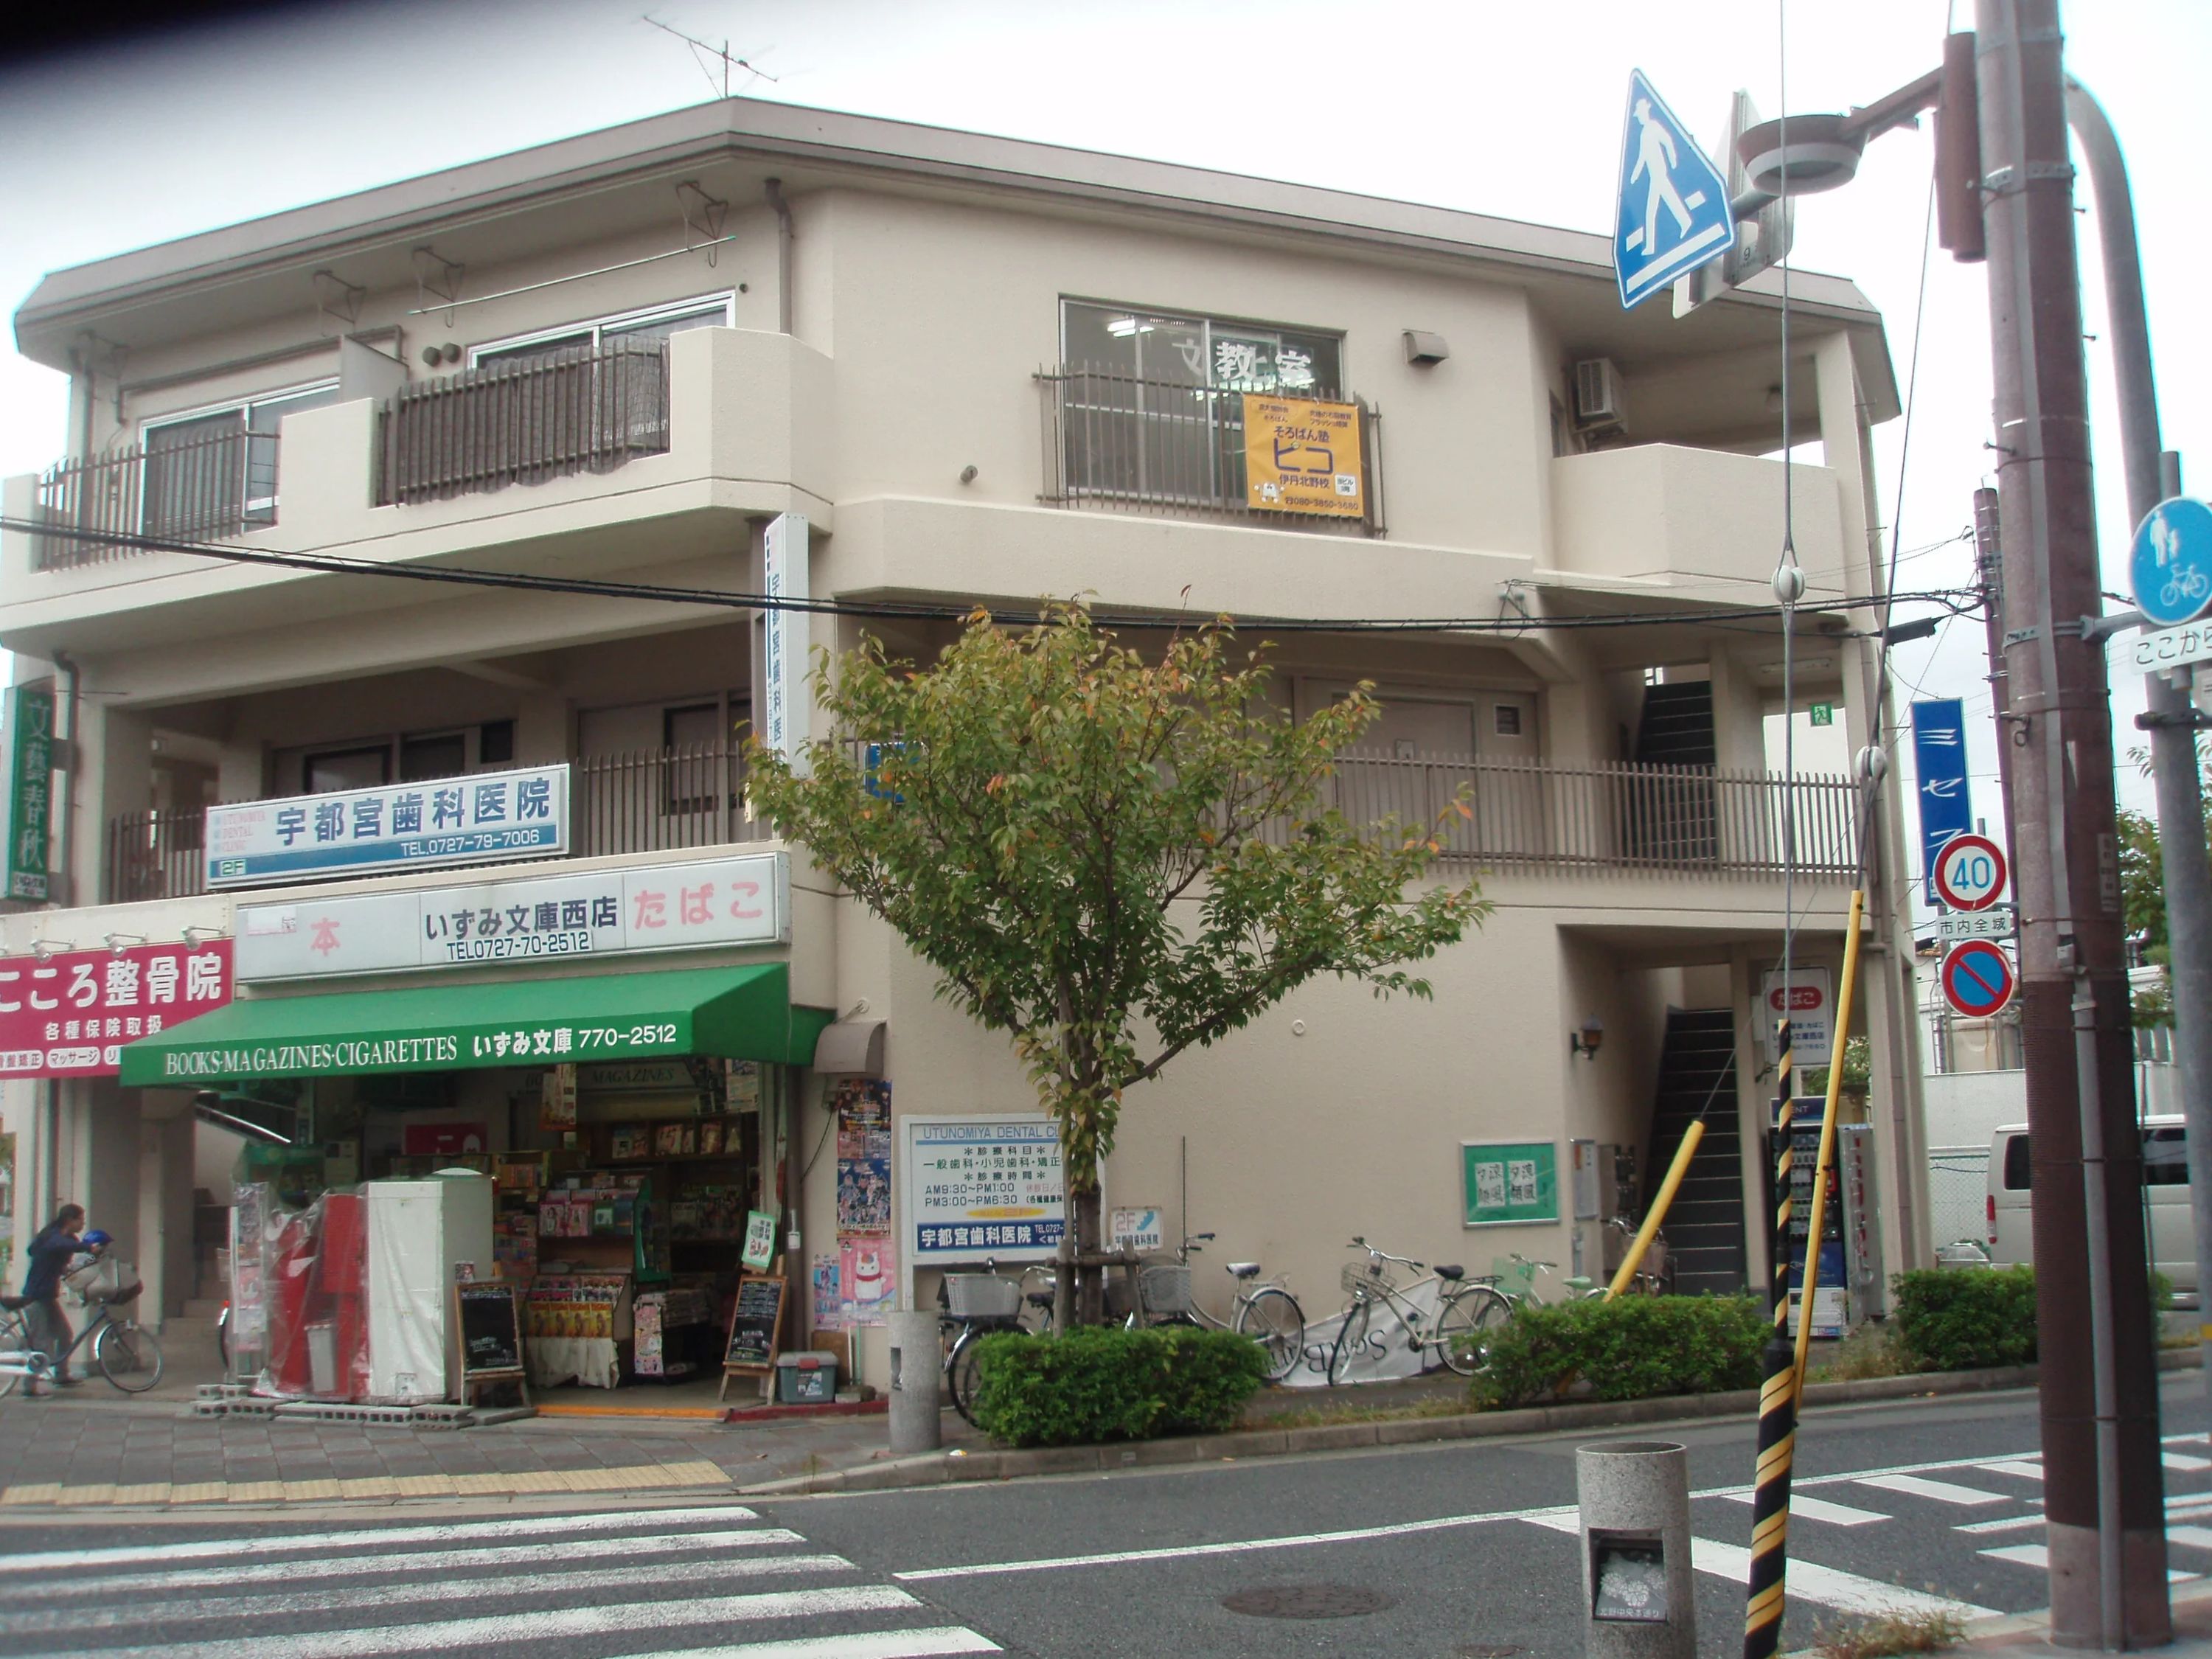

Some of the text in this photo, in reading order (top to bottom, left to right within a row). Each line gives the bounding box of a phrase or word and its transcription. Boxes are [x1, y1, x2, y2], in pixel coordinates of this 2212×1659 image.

[1274, 425, 1330, 442] そろばん塾
[1274, 437, 1333, 474] ピコ
[1279, 473, 1330, 489] 伊丹北野校
[276, 776, 551, 846] 宇都宮歯科医院
[400, 829, 540, 858] TEL.0727-79-7006
[221, 861, 244, 875] 2F
[1951, 856, 1990, 891] 40
[425, 895, 618, 940] いずみ文庫西店
[634, 881, 764, 931] たばこ
[310, 917, 341, 956] 本
[1940, 916, 2006, 934] 市内全域
[446, 932, 591, 961] TEL0727-70-2512
[0, 952, 222, 1012] こころ整骨院
[46, 1015, 163, 1040] 各種保険取扱
[473, 1027, 572, 1058] いずみ文庫
[579, 1023, 677, 1048] 770-2512
[50, 1049, 99, 1065] マッサージ
[108, 1049, 116, 1062] リ
[923, 1125, 1060, 1139] UTUNOMIYA DENTAL CL
[1116, 1212, 1135, 1231] 2F
[922, 1225, 1032, 1247] 宇都宮歯科医院
[1034, 1224, 1064, 1234] TEL.0727-
